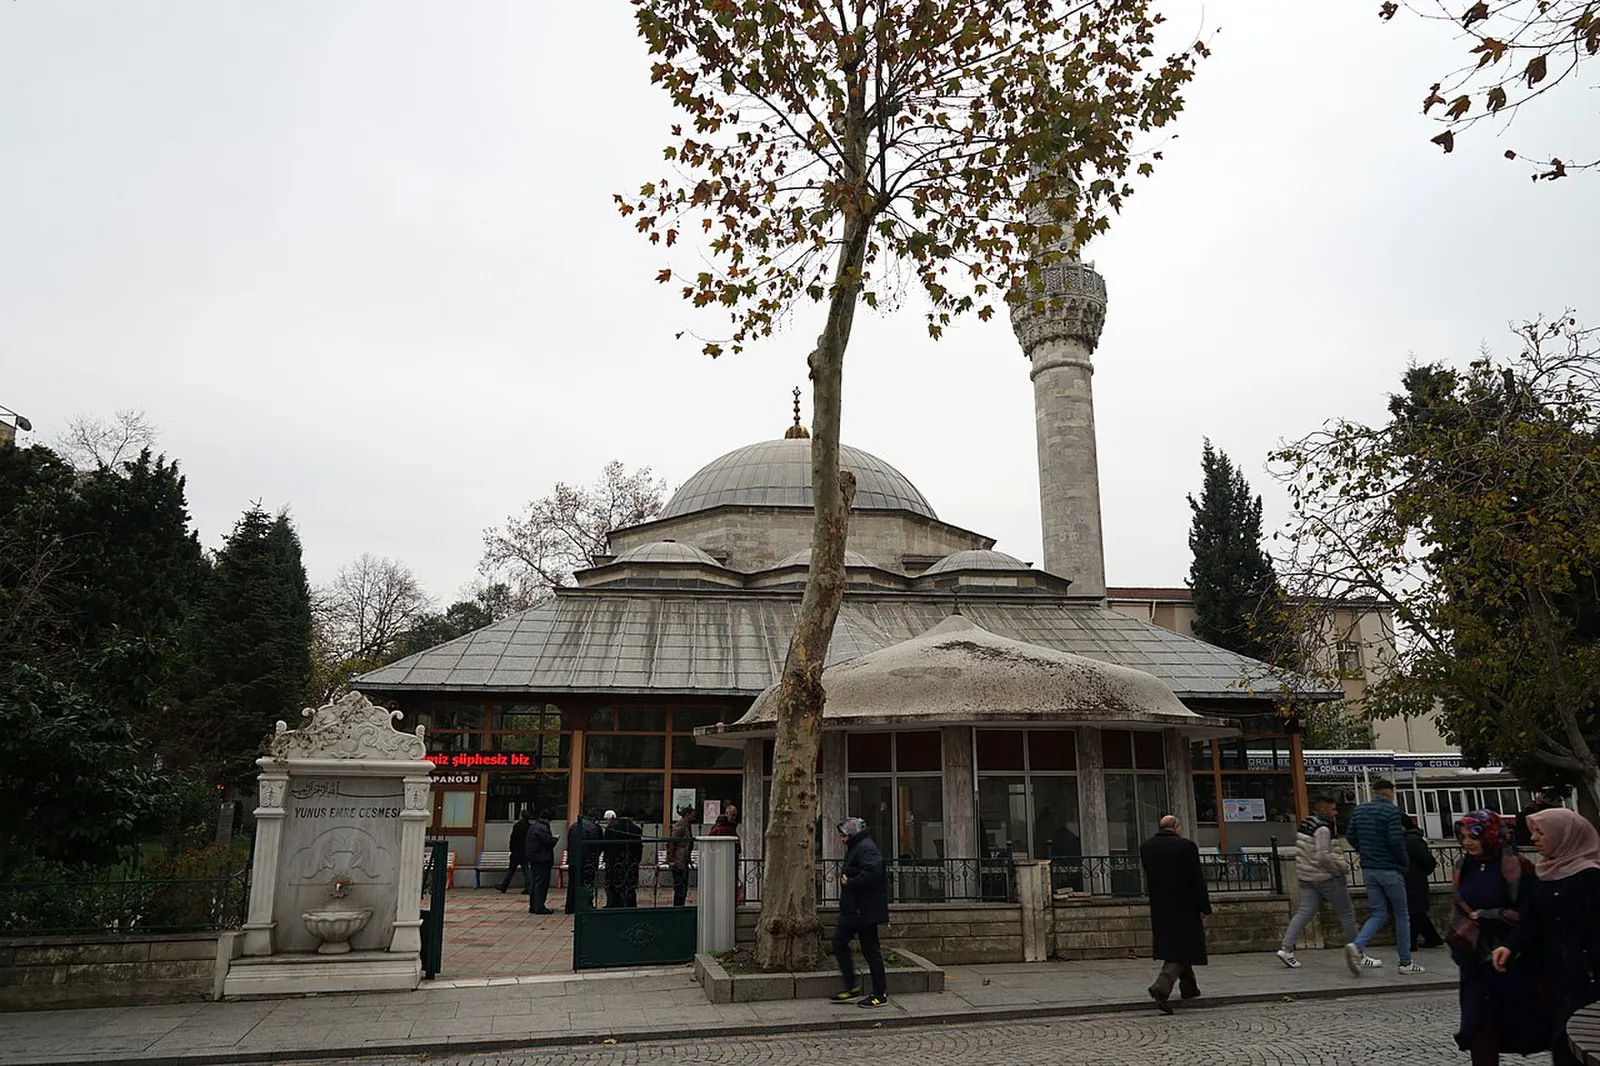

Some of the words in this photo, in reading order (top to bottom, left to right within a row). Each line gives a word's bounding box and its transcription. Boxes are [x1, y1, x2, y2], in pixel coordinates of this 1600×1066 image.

[452, 753, 508, 768] şüphesiz
[511, 753, 531, 765] biz
[295, 807, 327, 818] YUNUS
[329, 807, 356, 818] EMRE
